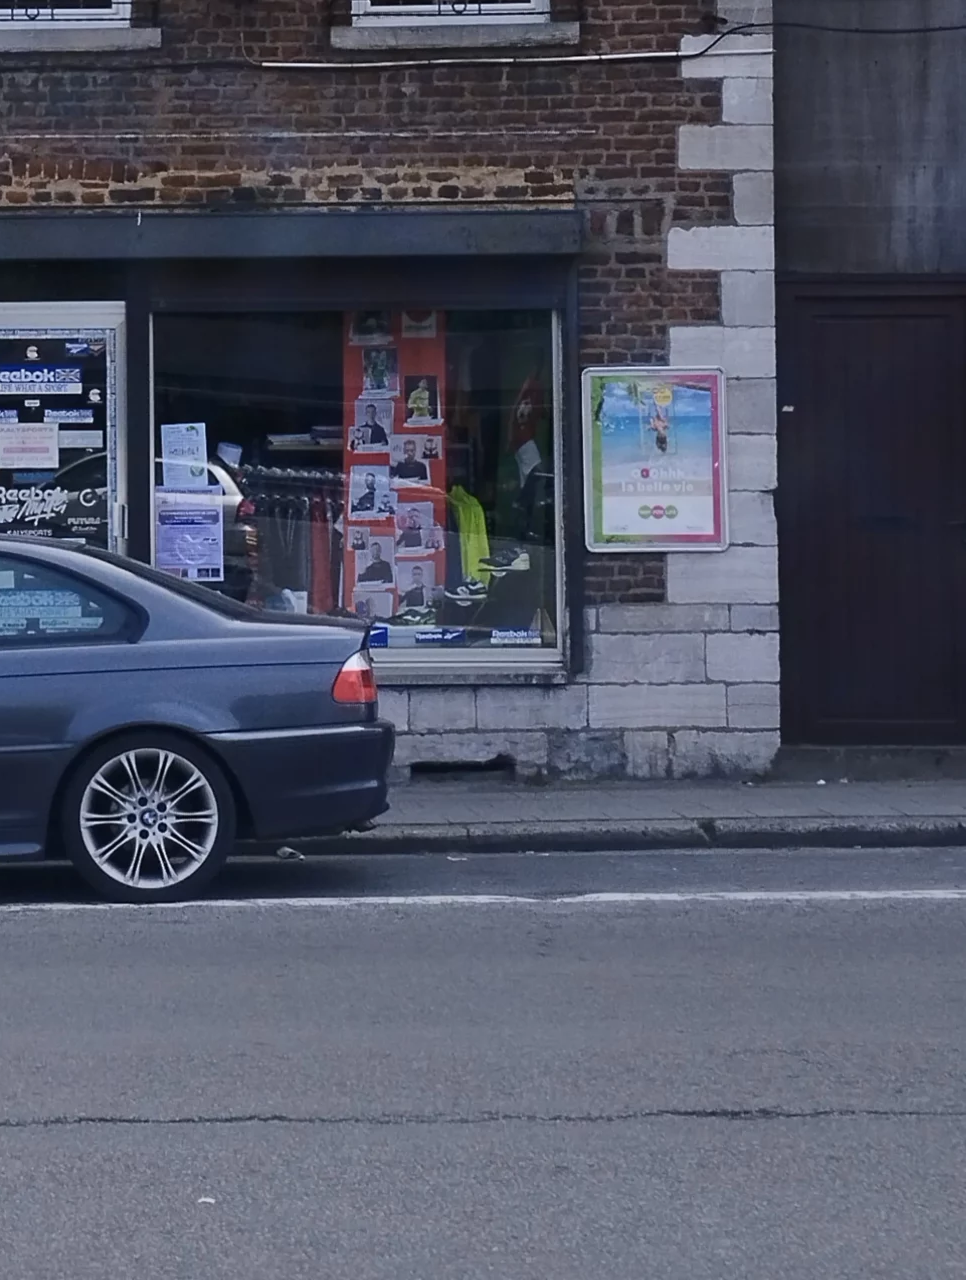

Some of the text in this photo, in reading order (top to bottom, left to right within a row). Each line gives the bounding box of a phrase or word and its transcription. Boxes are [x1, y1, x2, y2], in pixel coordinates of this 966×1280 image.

[15, 383, 37, 393] WHAT
[38, 383, 44, 393] A
[45, 383, 68, 393] SPORT
[636, 481, 671, 492] belle
[674, 481, 694, 492] vie
[492, 629, 527, 639] Reebok
